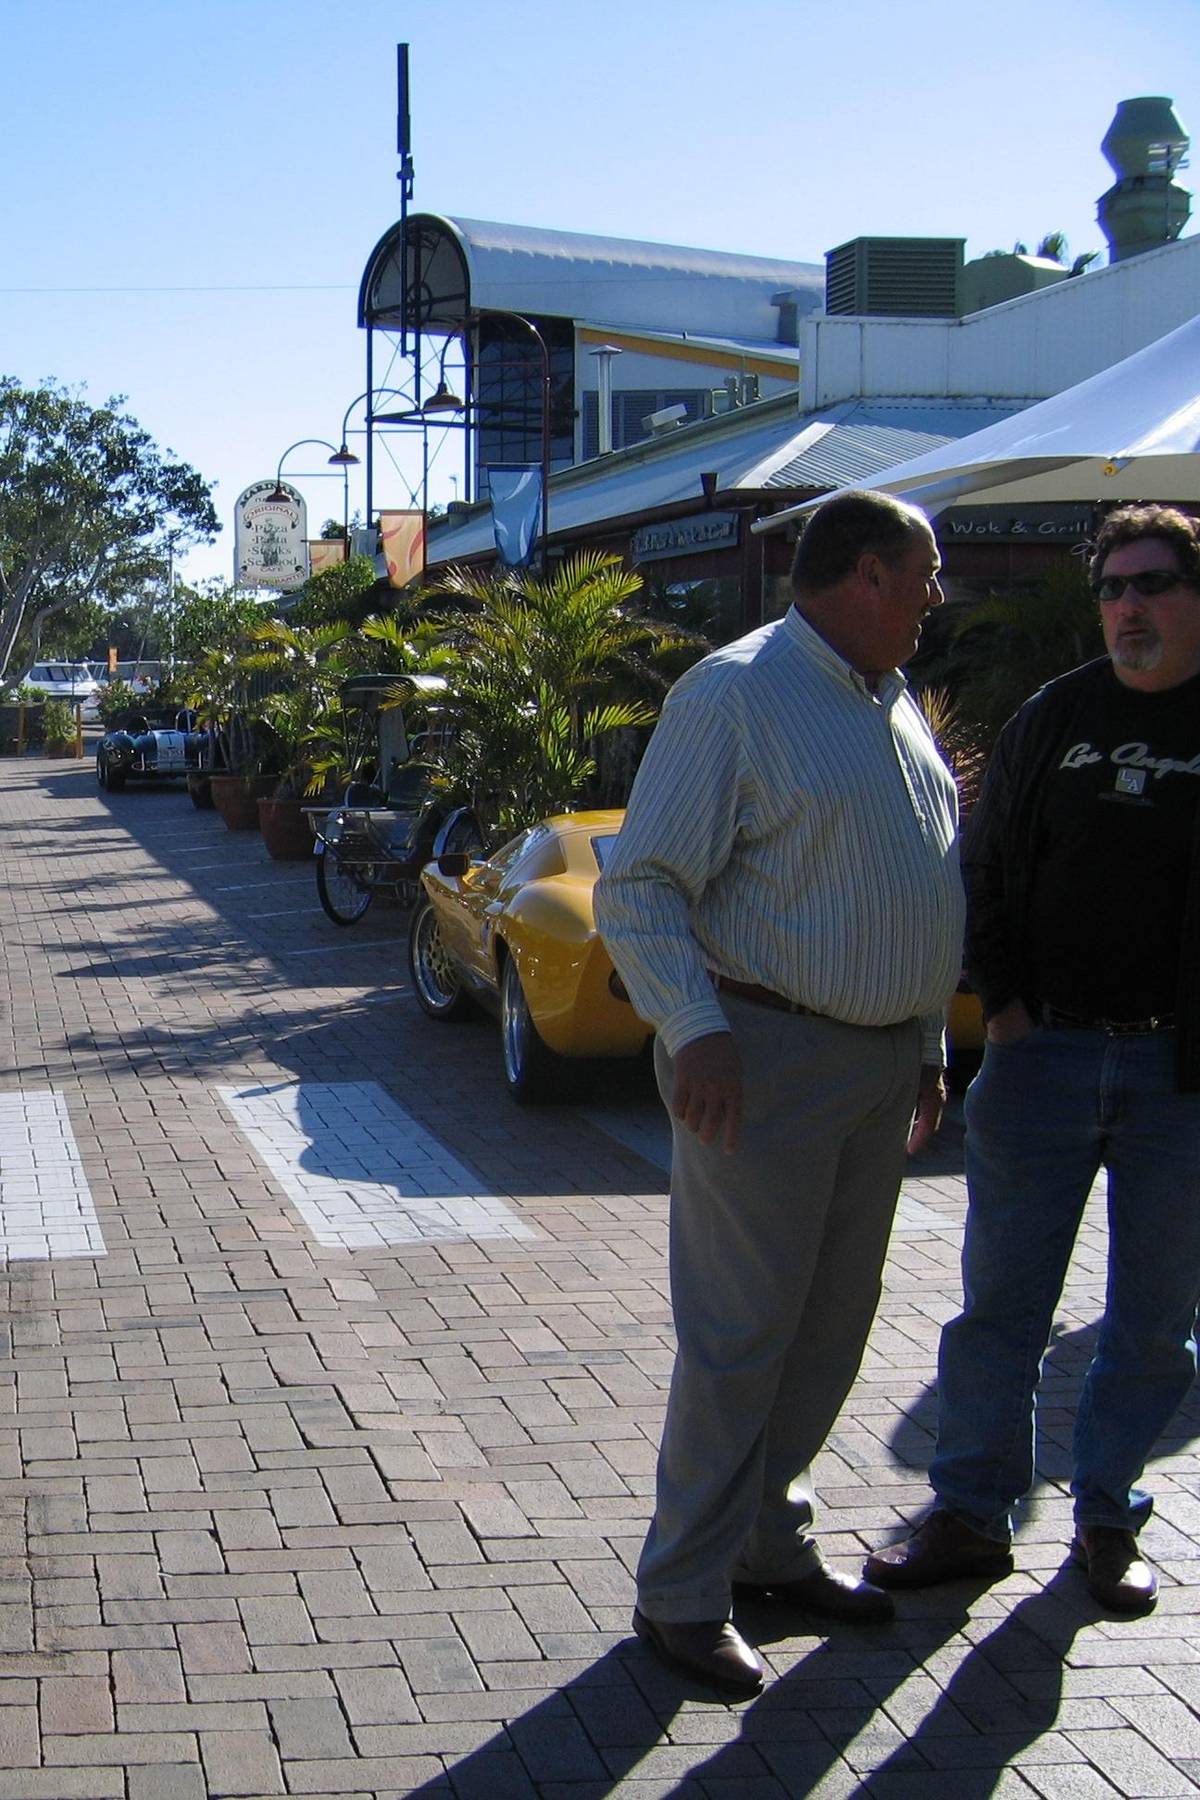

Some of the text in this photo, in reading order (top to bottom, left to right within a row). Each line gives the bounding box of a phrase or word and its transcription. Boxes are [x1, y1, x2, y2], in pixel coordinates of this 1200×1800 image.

[247, 505, 295, 519] ORIGINAL
[255, 524, 287, 533] Pizza
[951, 520, 1089, 535] Wok & Grill
